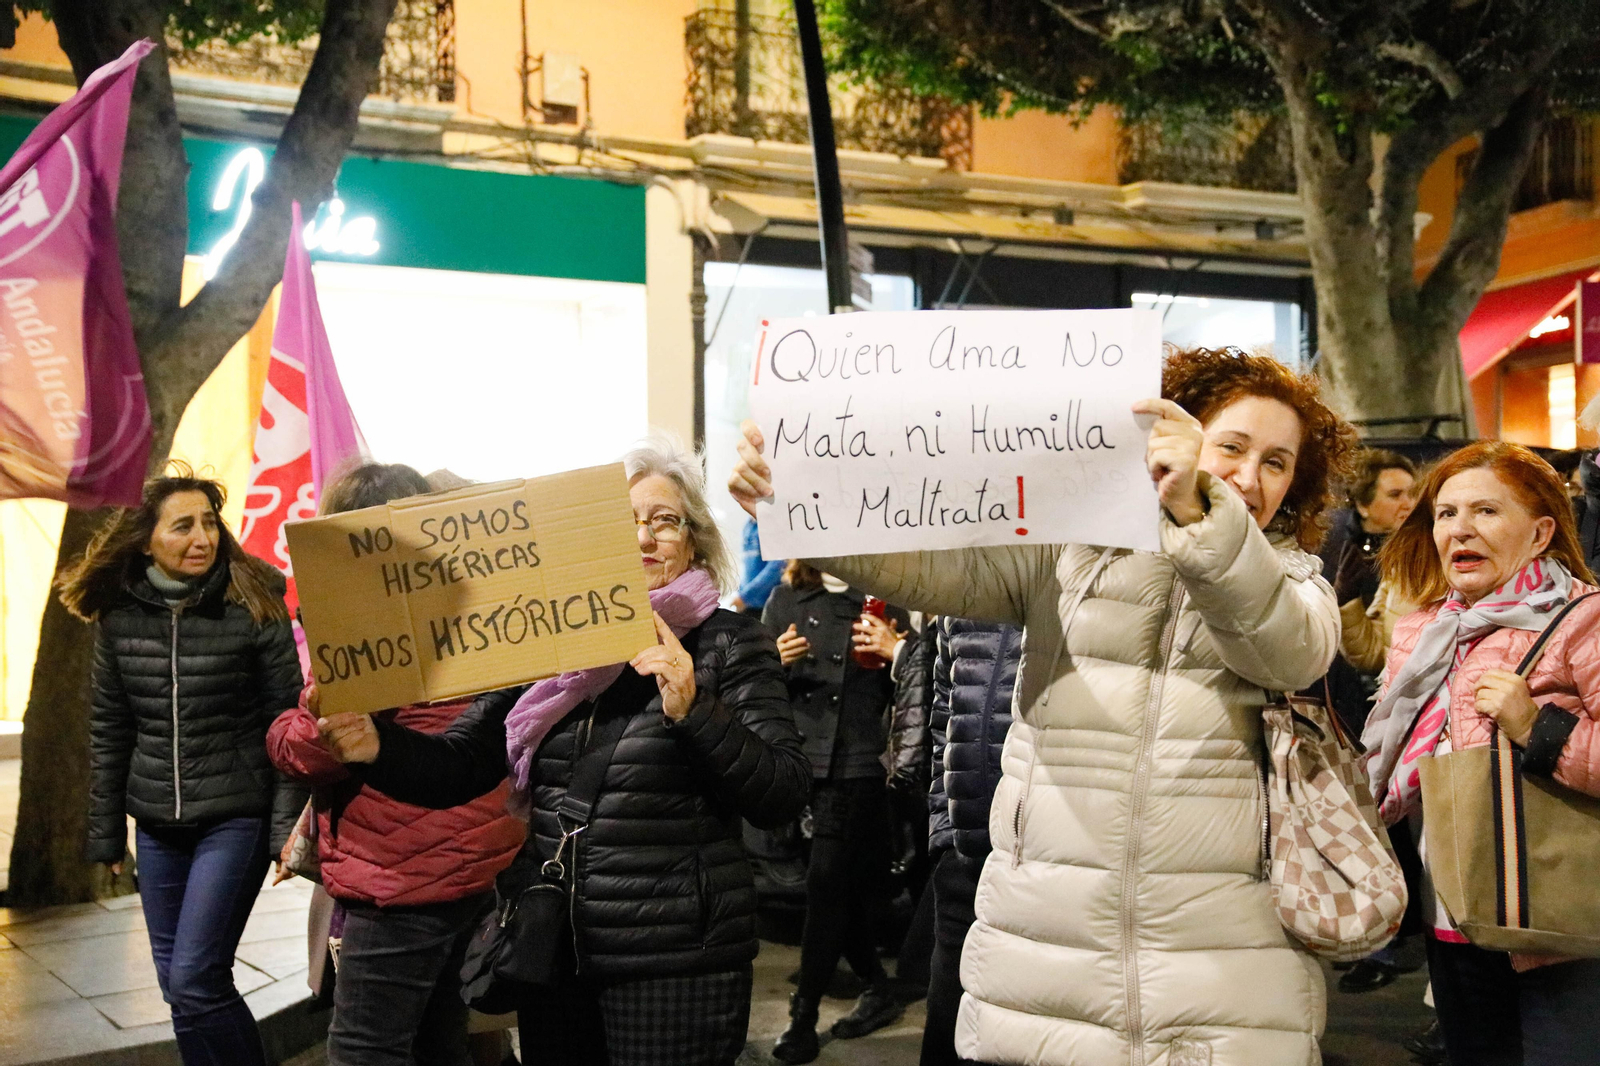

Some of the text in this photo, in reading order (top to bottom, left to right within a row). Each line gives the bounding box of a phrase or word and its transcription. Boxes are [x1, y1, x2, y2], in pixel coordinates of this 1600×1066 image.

[929, 325, 1026, 370] Ama
[1062, 330, 1123, 367] No
[905, 410, 946, 457] ni
[970, 398, 1116, 455] Humilla
[348, 499, 530, 559] NO SOMOS
[787, 475, 1029, 536] ni Maltrata!
[316, 584, 636, 685] SOMOS HISTÓRICAS
